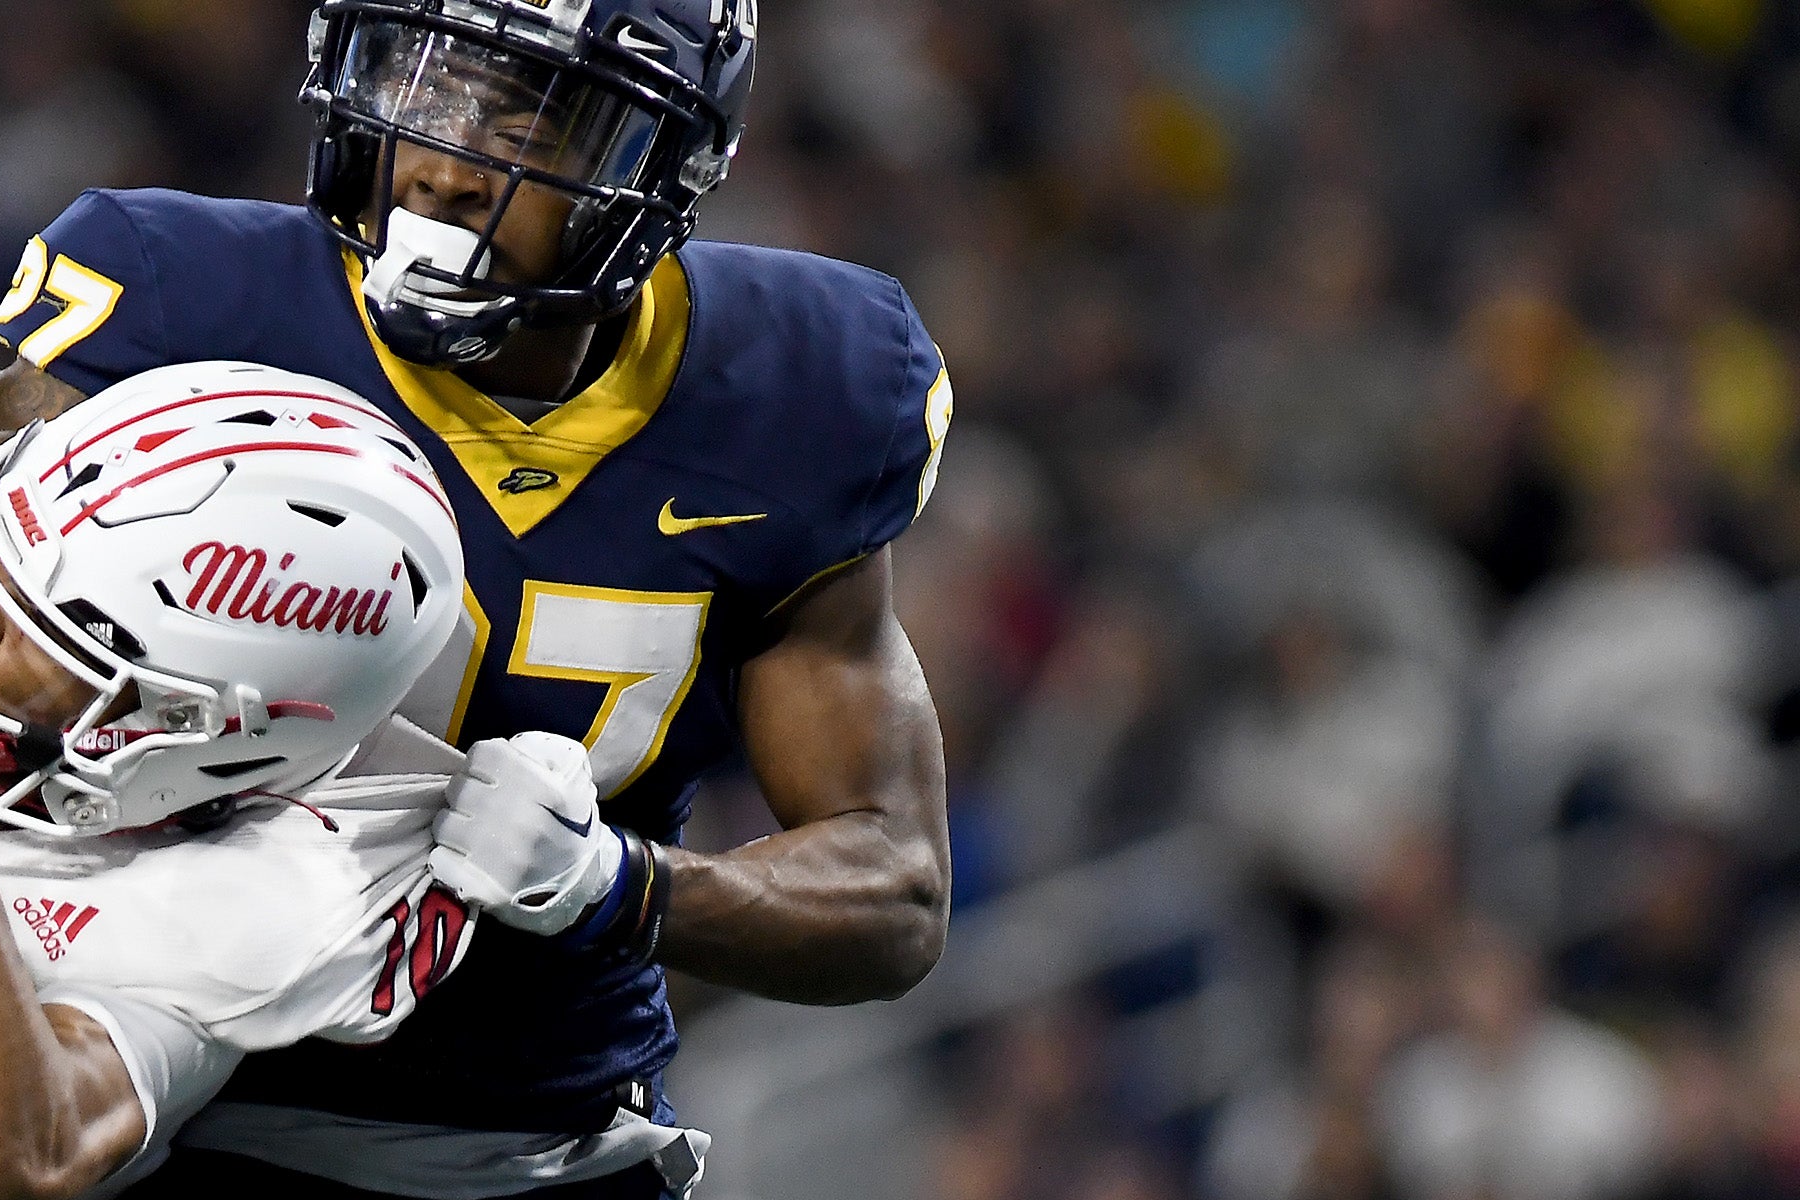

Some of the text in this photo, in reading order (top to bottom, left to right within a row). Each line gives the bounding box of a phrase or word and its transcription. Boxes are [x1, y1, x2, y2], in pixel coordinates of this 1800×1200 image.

[182, 541, 402, 636] Miami
[400, 577, 713, 800] 7
[13, 897, 66, 961] adidas
[370, 879, 469, 1017] 10
